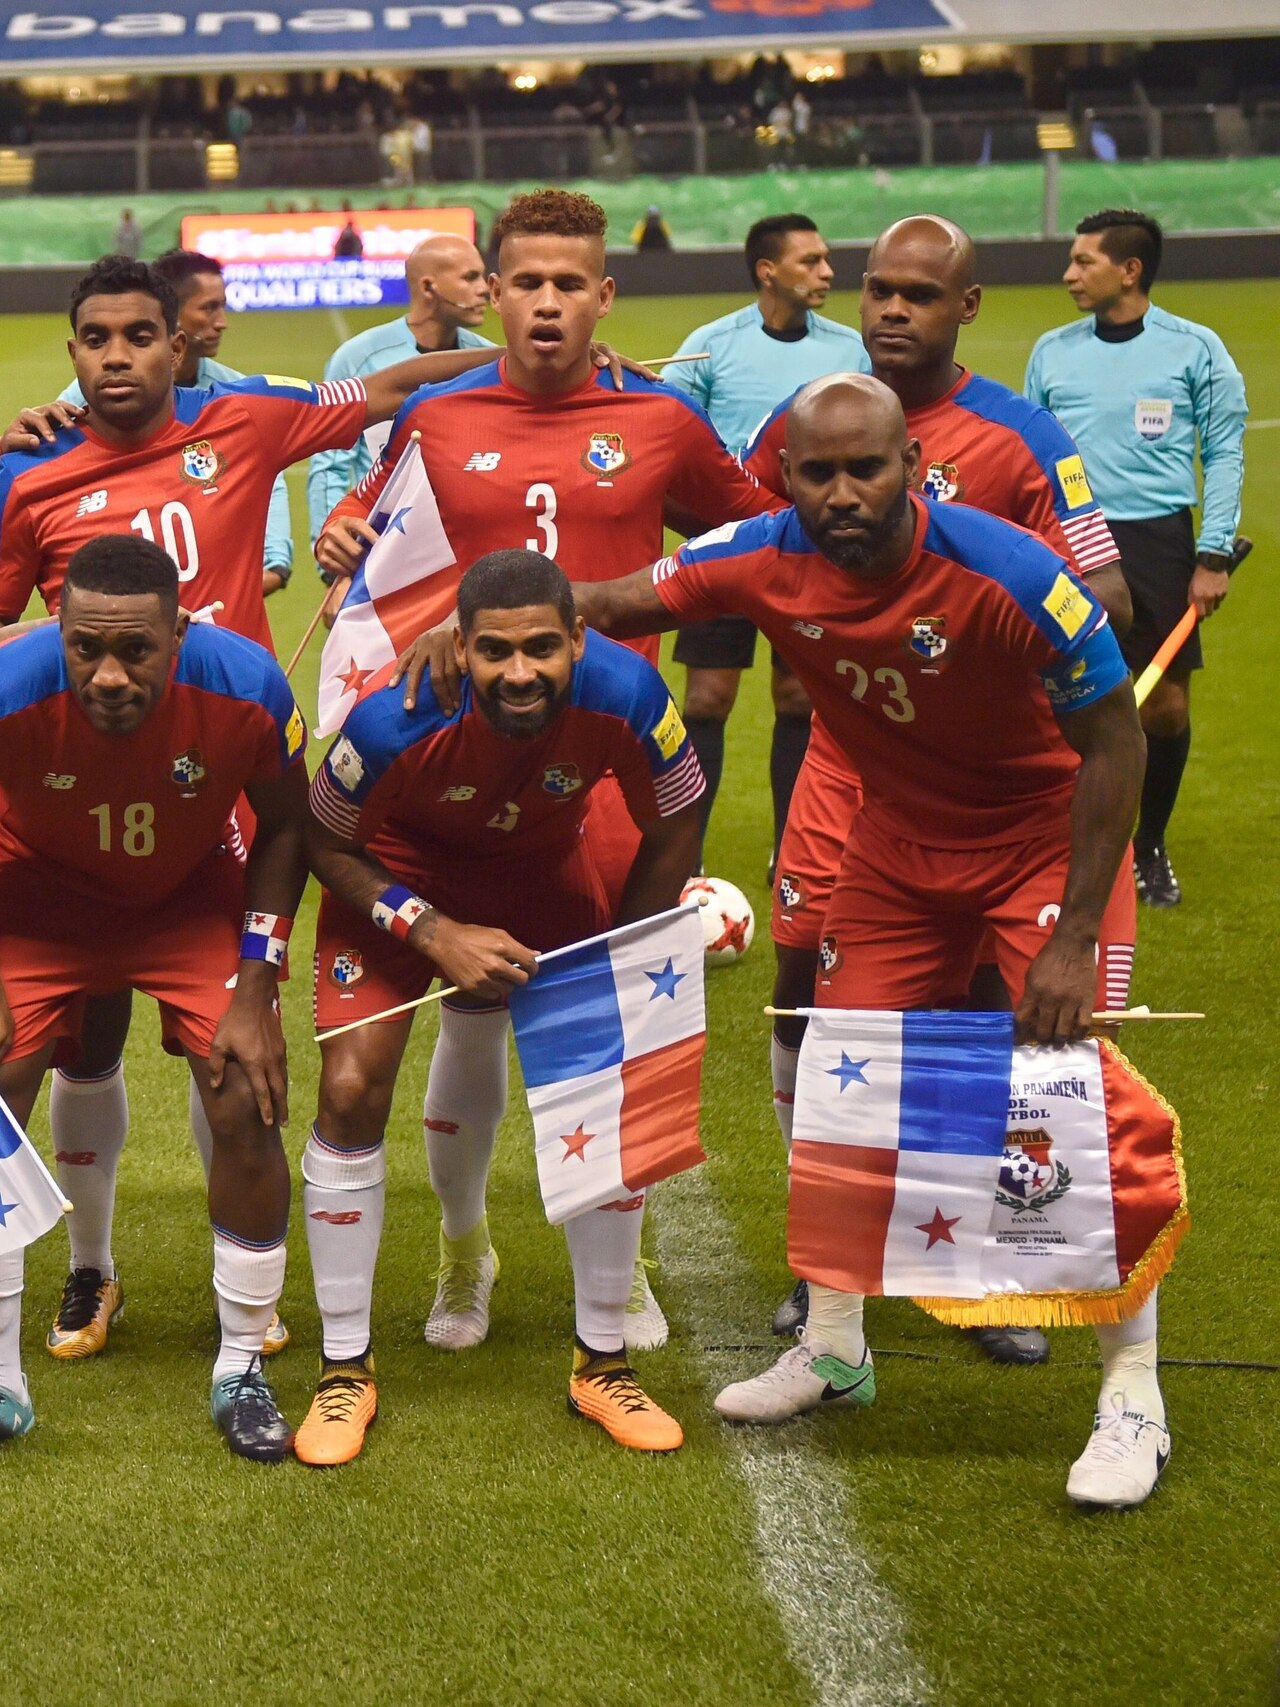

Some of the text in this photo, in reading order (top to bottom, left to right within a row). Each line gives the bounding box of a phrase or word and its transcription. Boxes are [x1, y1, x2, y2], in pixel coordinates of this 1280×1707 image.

[225, 278, 383, 310] QUALIFIERS
[1142, 416, 1164, 425] FIFA
[1063, 472, 1084, 486] FIFA
[525, 482, 558, 560] 3
[130, 501, 199, 582] 10
[1056, 597, 1071, 618] FIFA
[835, 659, 916, 723] 23
[660, 723, 676, 745] FIFA
[88, 802, 155, 857] 18
[1023, 1076, 1088, 1101] PANAMEÑA
[1008, 1098, 1028, 1109] DE
[1008, 1109, 1050, 1120] TBOL
[1011, 1216, 1049, 1224] PANAMA
